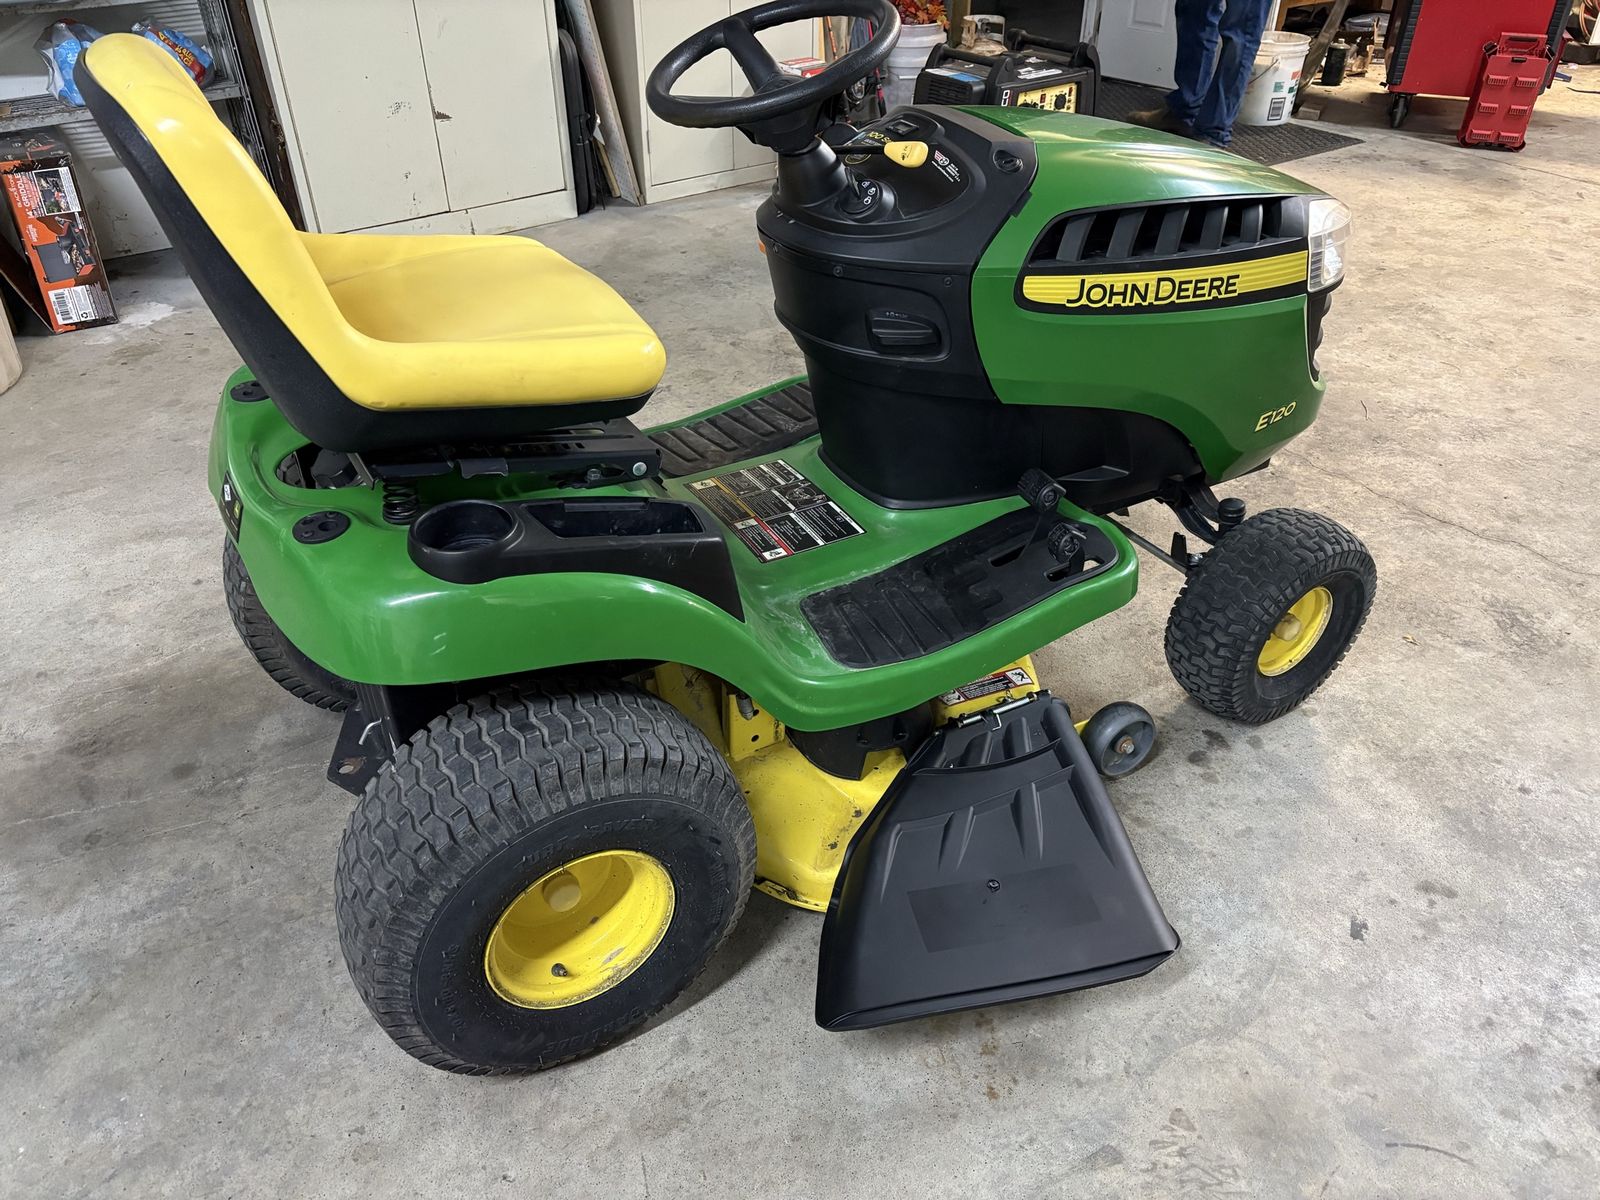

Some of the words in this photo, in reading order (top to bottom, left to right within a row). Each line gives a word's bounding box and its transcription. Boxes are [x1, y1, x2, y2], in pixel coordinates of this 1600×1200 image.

[14, 172, 32, 208] GRIDDLE
[1066, 278, 1150, 305] JOHN
[1154, 274, 1240, 303] DEERE
[1254, 401, 1297, 432] E120
